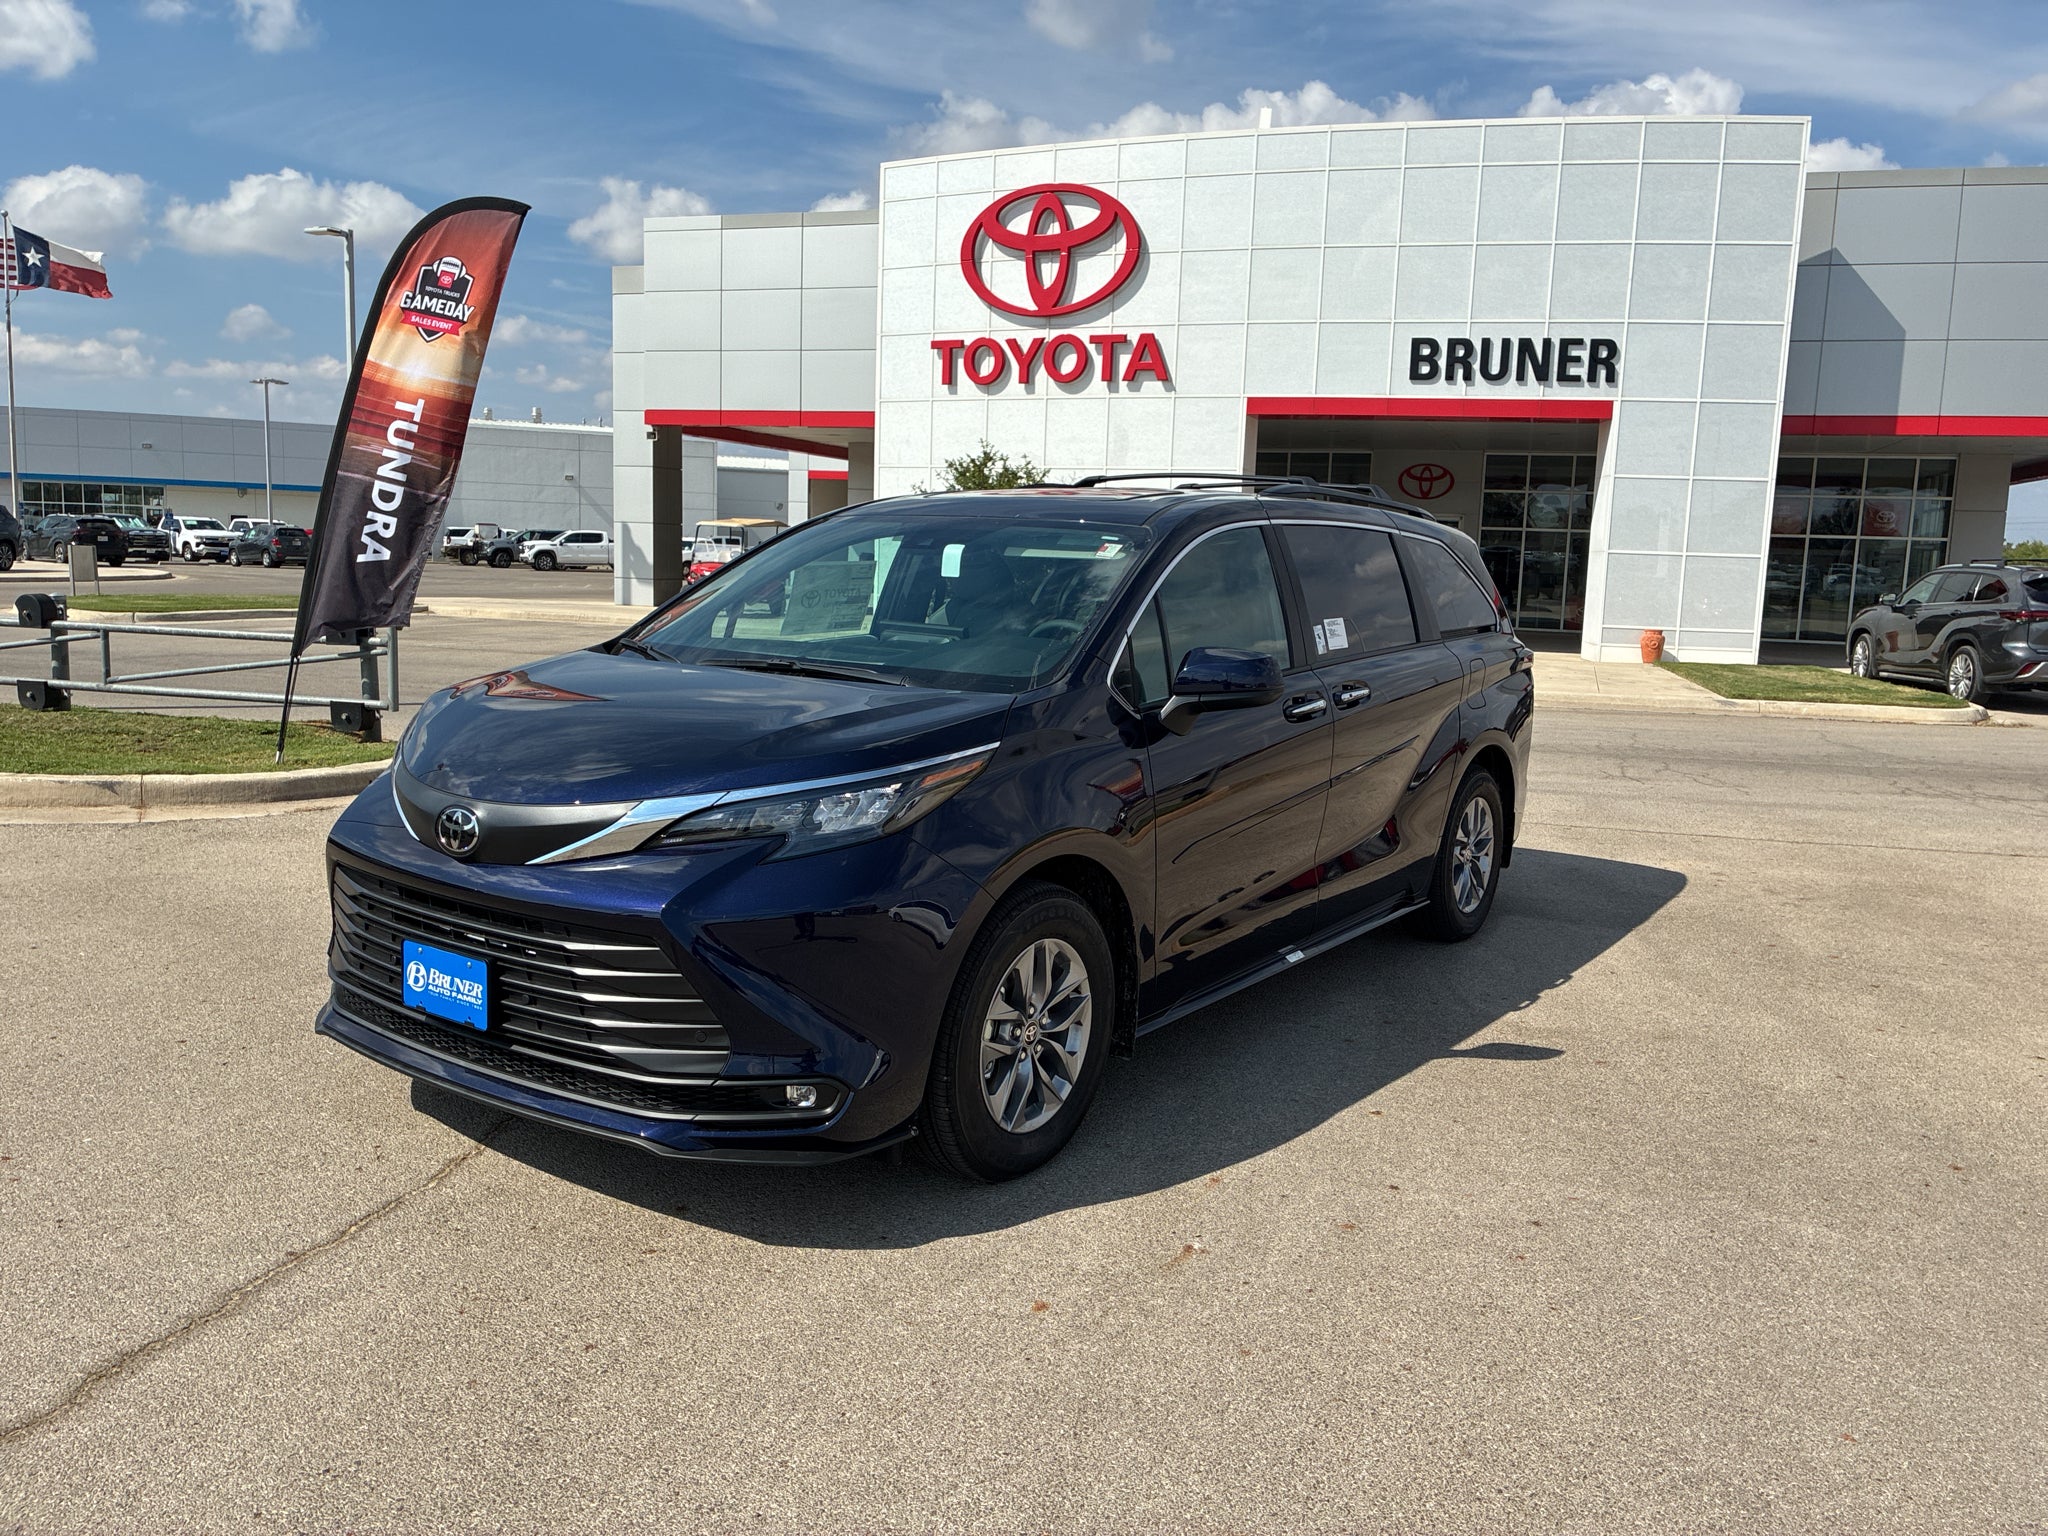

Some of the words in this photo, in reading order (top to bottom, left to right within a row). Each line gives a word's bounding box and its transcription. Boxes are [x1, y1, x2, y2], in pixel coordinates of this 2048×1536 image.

[400, 290, 475, 322] GAMEDAY
[411, 315, 432, 326] SALES
[432, 319, 453, 330] EVENT
[931, 333, 1168, 385] TOYOTA
[1409, 337, 1618, 383] BRUNER
[356, 398, 425, 563] TUNDRA
[427, 984, 450, 995] AUTO
[451, 992, 483, 1005] FAMILY
[428, 967, 483, 998] BRUNER
